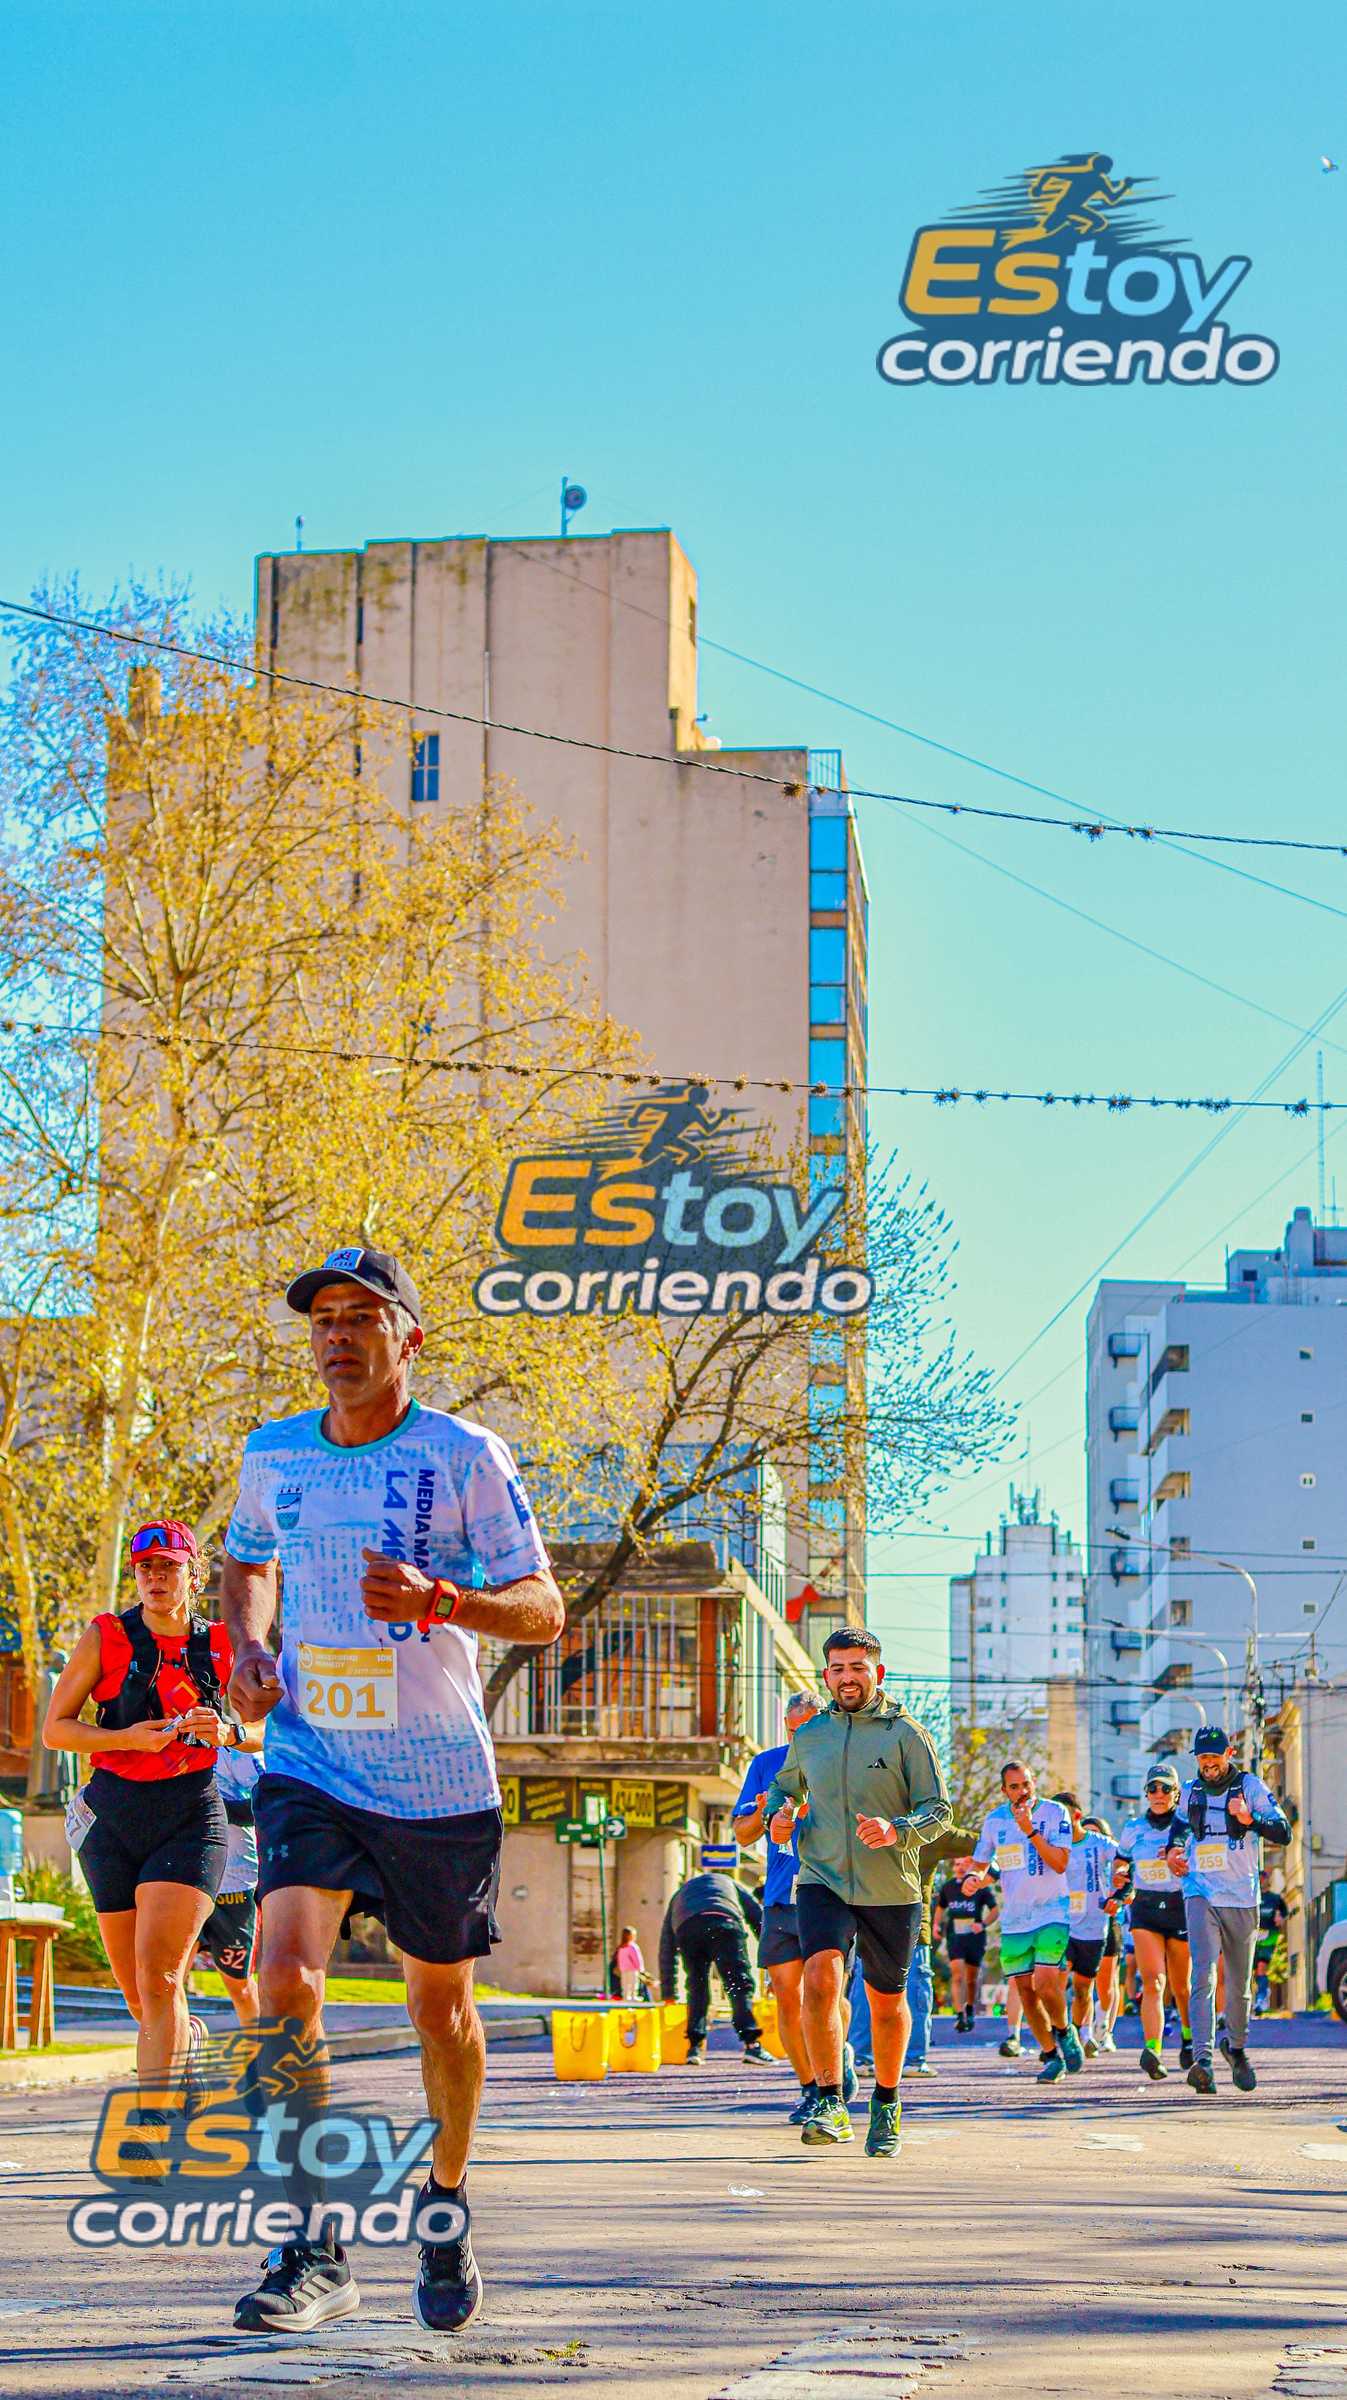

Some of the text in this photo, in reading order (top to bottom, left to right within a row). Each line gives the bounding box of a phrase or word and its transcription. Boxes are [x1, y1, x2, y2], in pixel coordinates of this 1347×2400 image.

[383, 1470, 408, 1508] LA
[414, 1469, 435, 1535] MEDIA
[306, 1679, 385, 1719] 201
[1199, 1856, 1223, 1869] 259
[220, 1948, 247, 1970] 32
